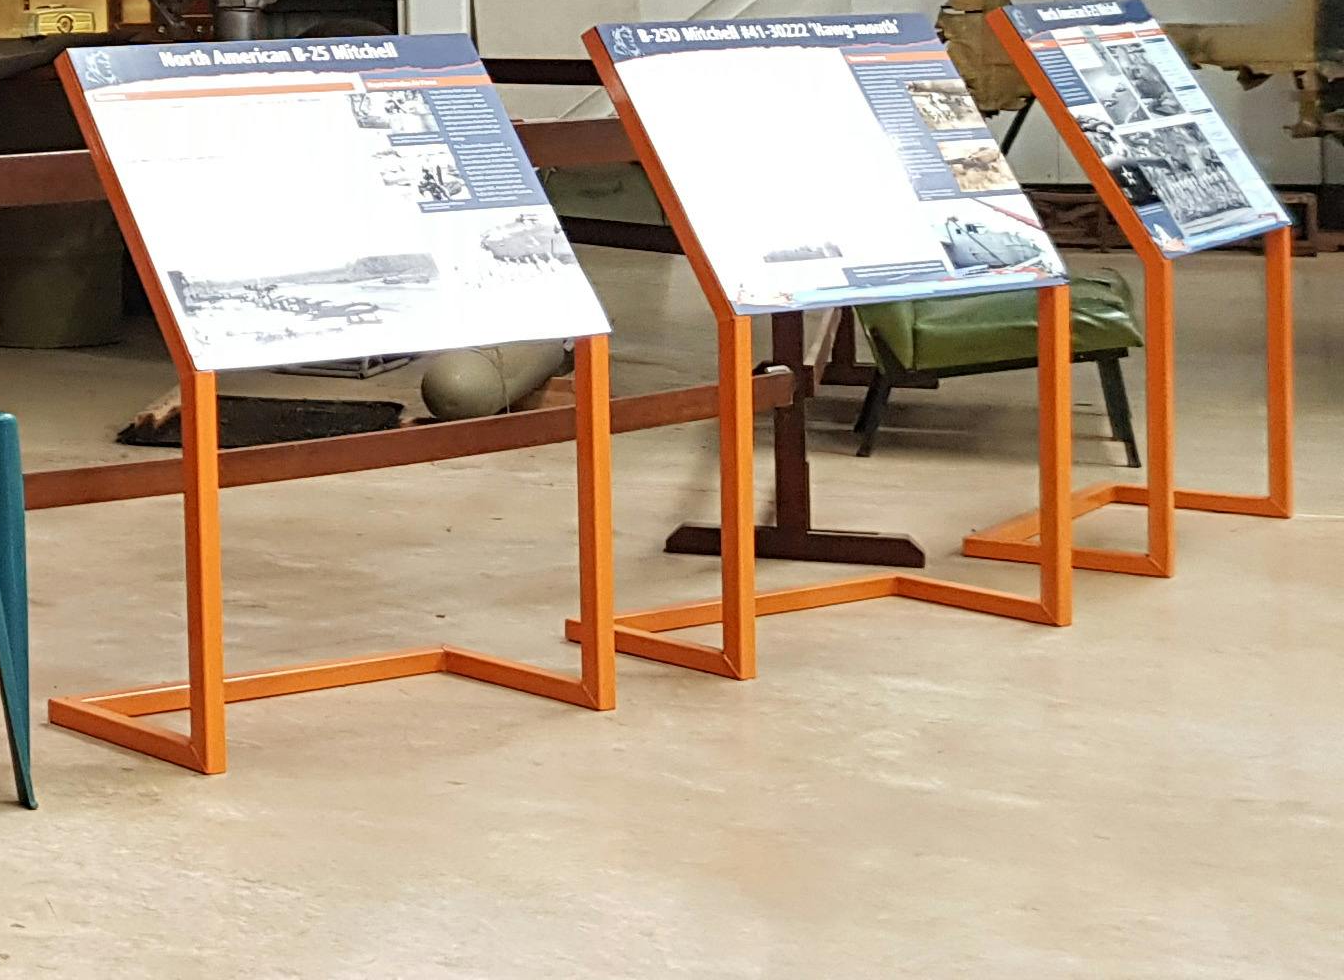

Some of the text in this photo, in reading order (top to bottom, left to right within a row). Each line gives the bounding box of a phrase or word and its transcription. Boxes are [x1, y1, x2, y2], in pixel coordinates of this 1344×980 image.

[636, 28, 678, 43] B-25D
[681, 24, 740, 41] Mitchell
[740, 22, 810, 39] #41-30222
[159, 42, 399, 68] North American B-25 Mitchell
